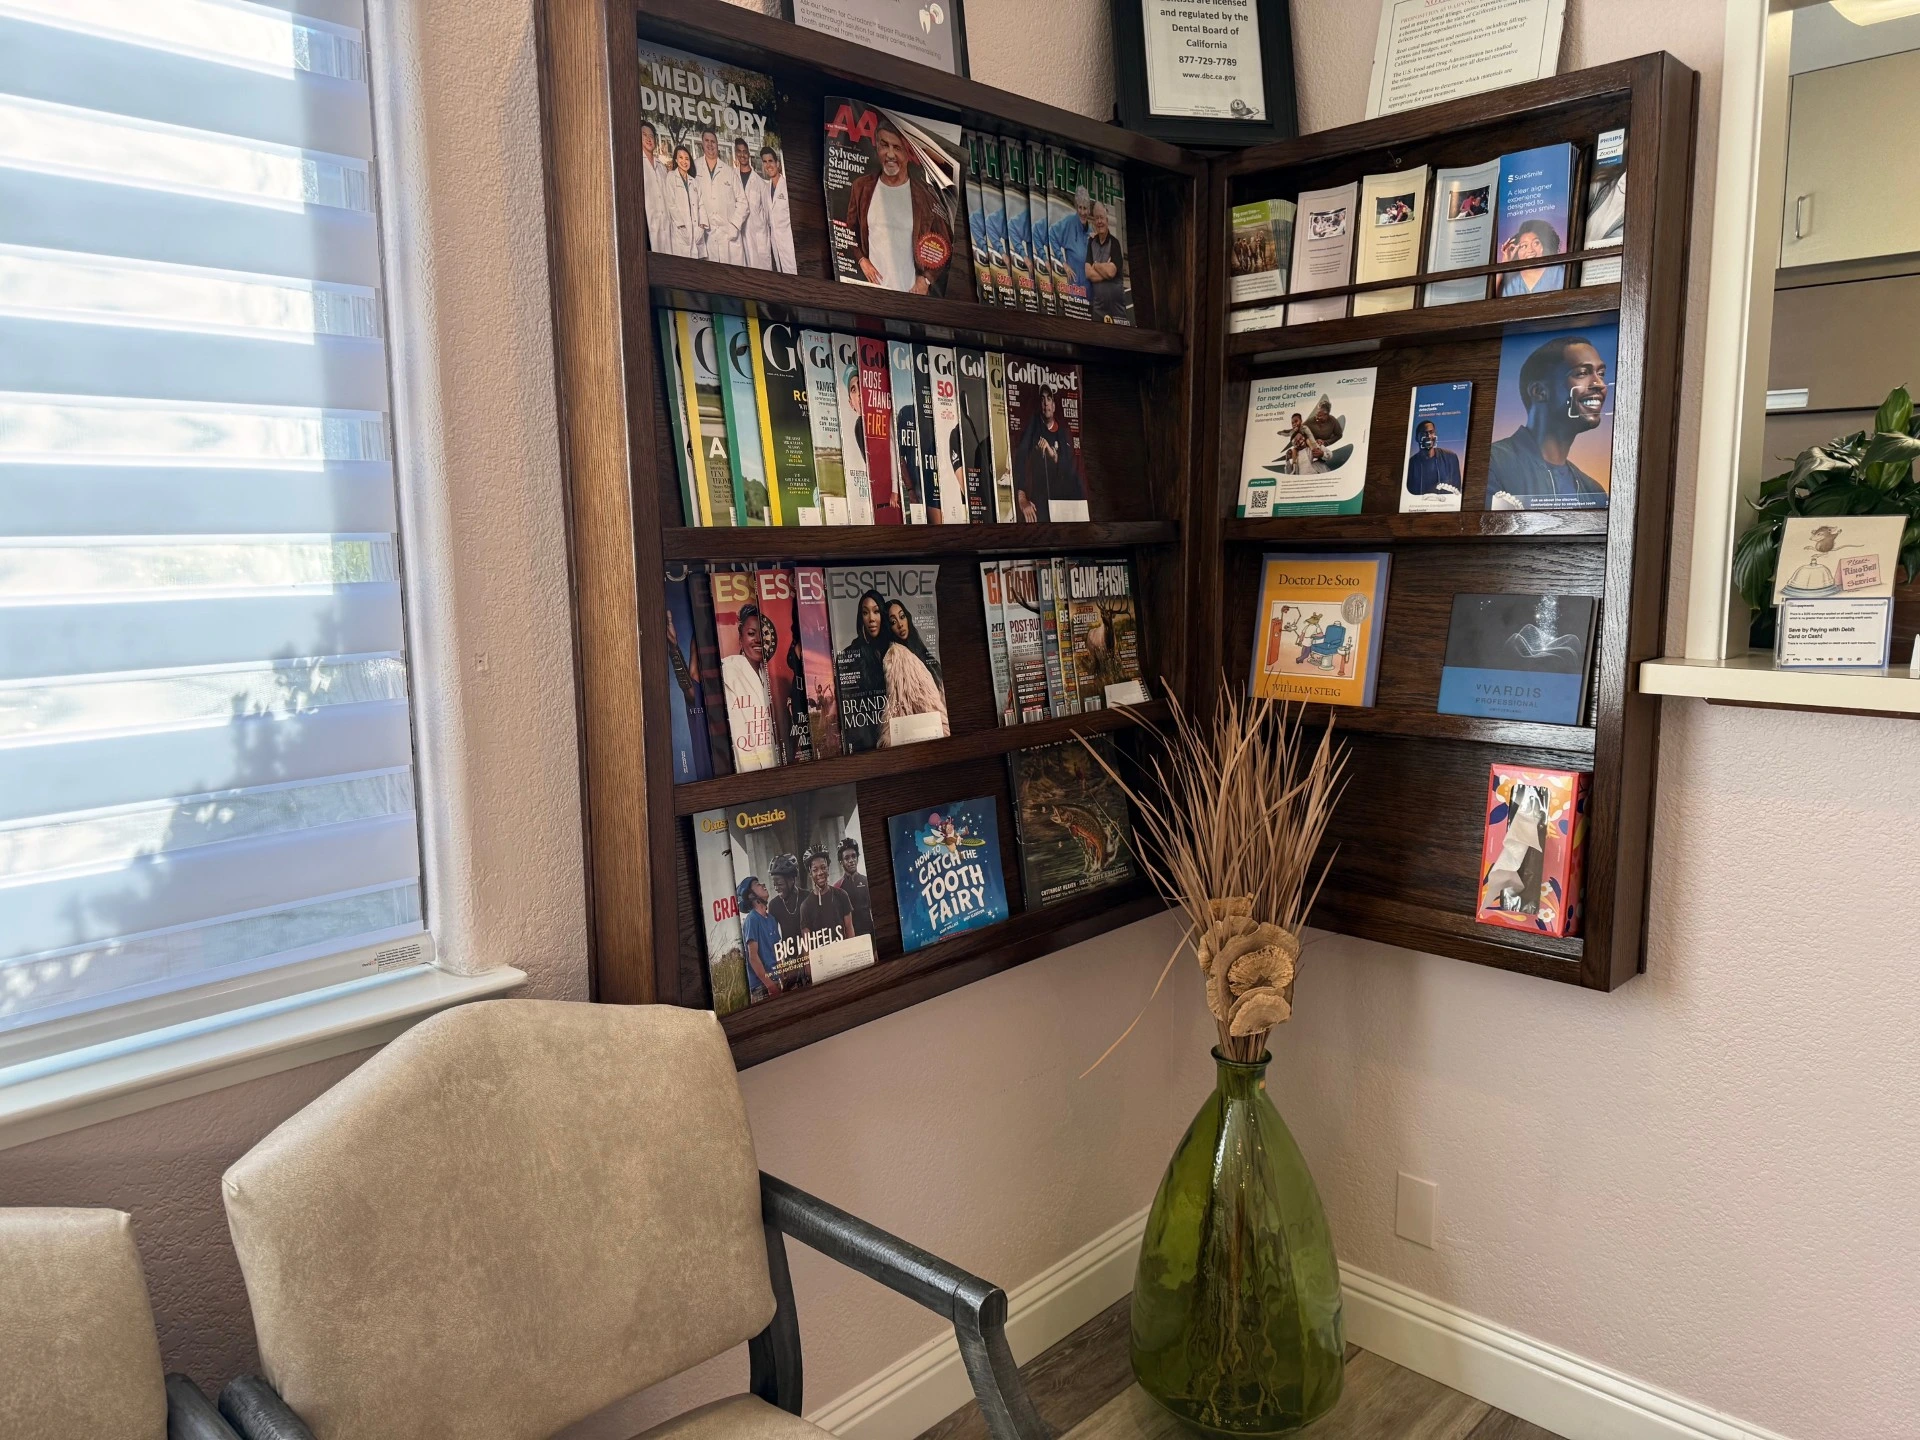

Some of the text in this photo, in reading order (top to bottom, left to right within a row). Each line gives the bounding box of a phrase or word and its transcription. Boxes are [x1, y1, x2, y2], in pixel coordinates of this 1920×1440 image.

[1160, 9, 1249, 22] and regulated by the
[1172, 24, 1240, 35] Dental Board of
[1186, 39, 1228, 49] California
[1179, 56, 1237, 66] 877-729-7789
[1182, 72, 1236, 81] www.dbc.ca.gov
[652, 62, 753, 110] MEDICAL
[641, 85, 767, 137] DIRECTORY
[1600, 134, 1622, 143] PHILIPS
[829, 146, 869, 164] Sylvester
[829, 156, 865, 174] Stallone
[1514, 170, 1543, 180] SureSmile
[1530, 183, 1552, 192] aligner
[1507, 193, 1541, 204] experience
[1507, 199, 1536, 211] designed
[1506, 210, 1524, 218] make
[1539, 204, 1556, 212] smile
[862, 369, 882, 389] ROSE
[1007, 361, 1078, 394] GolfDigest
[937, 380, 954, 398] 50
[1258, 384, 1298, 393] Limited-time
[1282, 390, 1316, 400] CareCredit
[868, 389, 892, 410] ZHANG
[1061, 398, 1078, 409] CAPTAIN
[1256, 401, 1296, 411] cardholders!
[1063, 408, 1079, 419] KEEGAN
[866, 413, 887, 436] FIRE
[831, 569, 935, 600] ESSENCE
[1070, 565, 1099, 599] GAME
[1102, 566, 1126, 596] FISH
[1278, 574, 1360, 586] Doctor De Soto
[1073, 612, 1098, 624] SEPTEMBER
[1272, 683, 1341, 697] WILLIAM STEIG
[732, 695, 755, 710] ALL
[842, 695, 891, 715] BRANDY
[1475, 698, 1538, 708] PROFESSIONAL
[745, 719, 770, 734] THE
[736, 809, 786, 829] Outside
[915, 846, 941, 868] HOW TO
[919, 850, 978, 884] CATCH THE
[922, 864, 985, 906] TOOTH
[774, 925, 844, 962] BIG WHEELS
